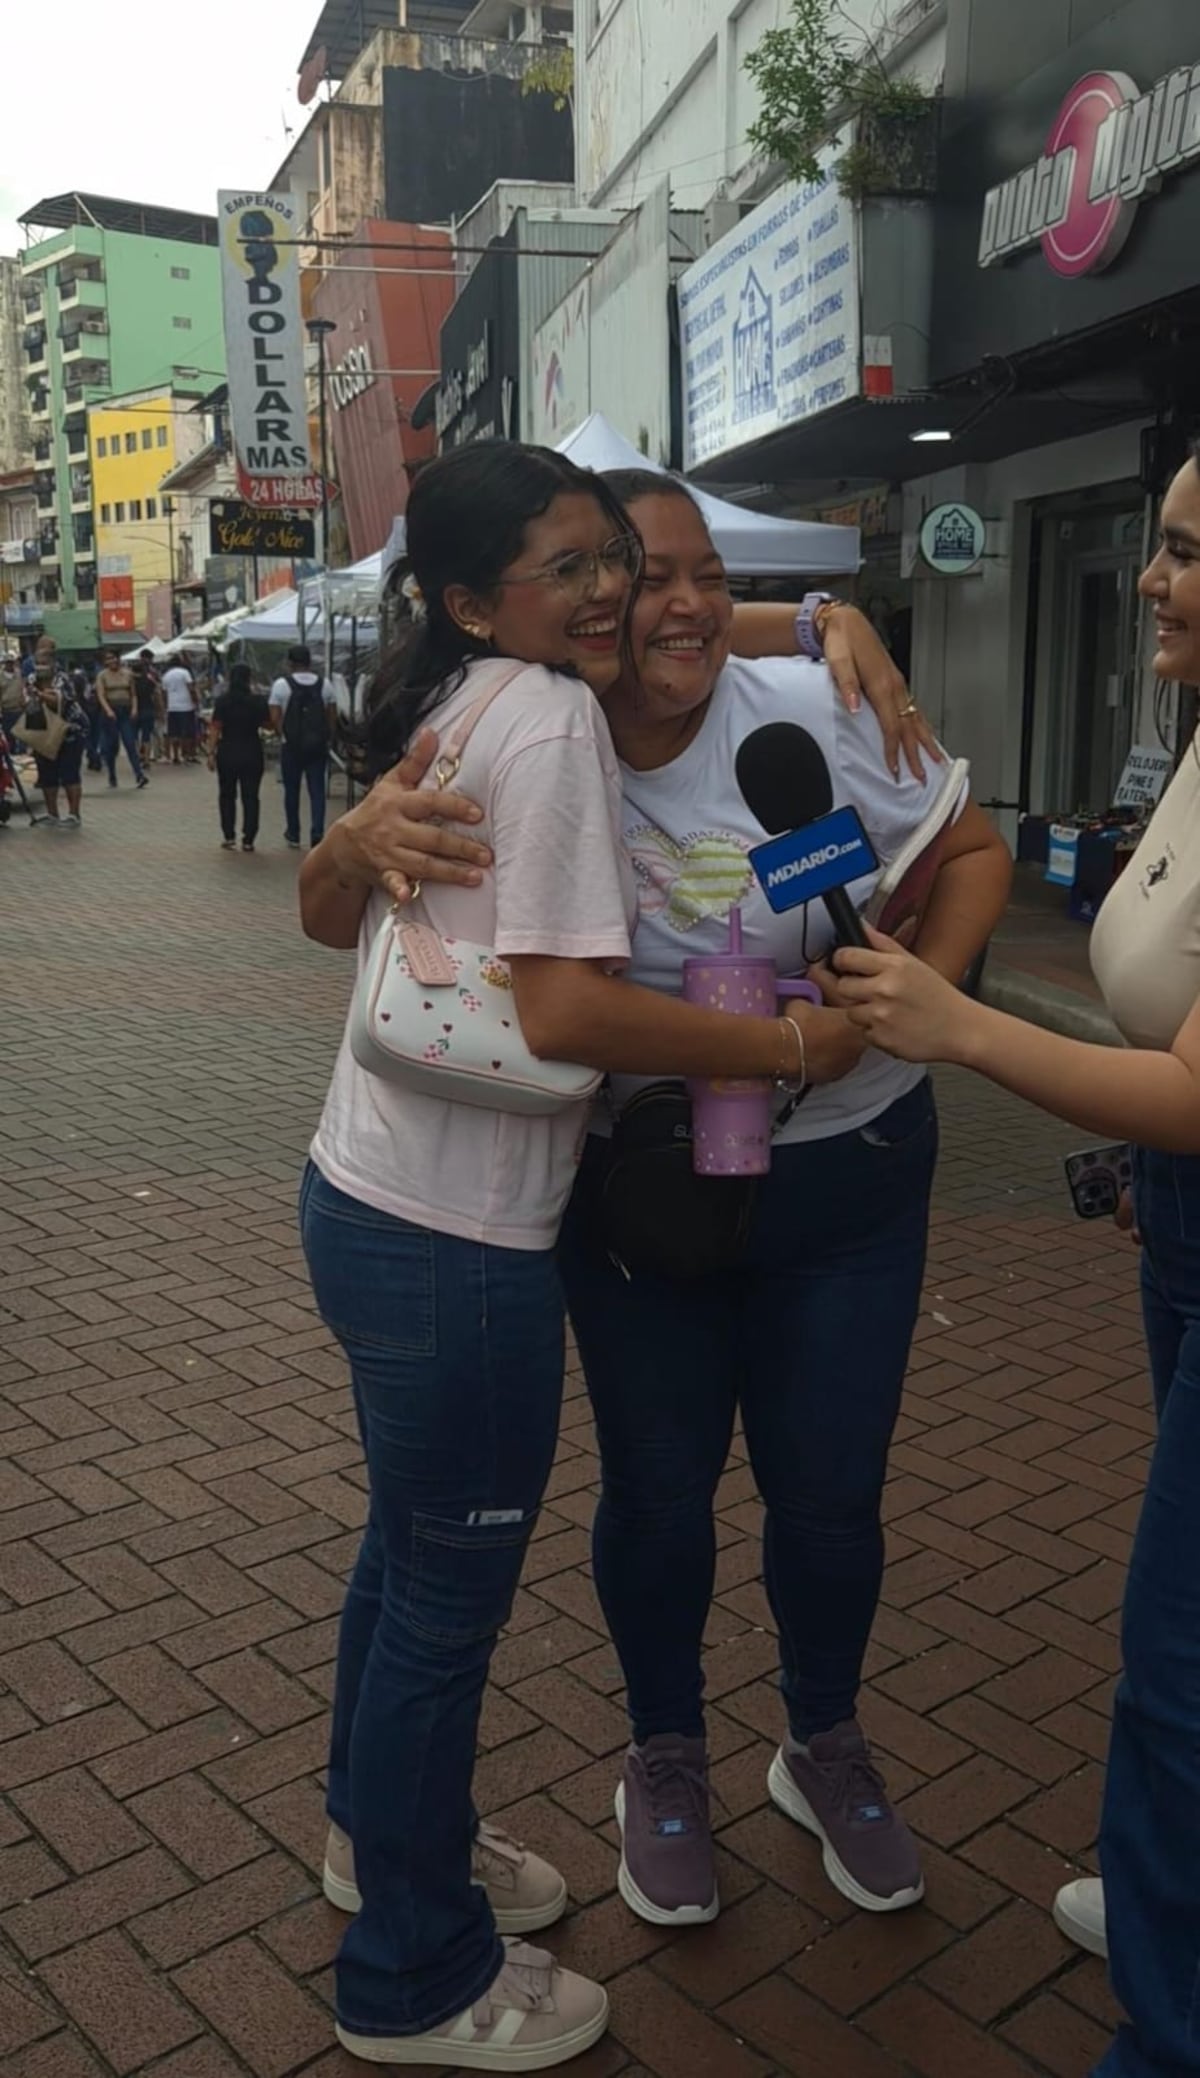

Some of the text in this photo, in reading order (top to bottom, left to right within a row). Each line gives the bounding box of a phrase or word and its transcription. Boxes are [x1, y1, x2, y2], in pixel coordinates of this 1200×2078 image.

[224, 193, 294, 220] EMPEÑOS
[245, 280, 293, 442] DOLLAR
[246, 445, 308, 469] MAS
[250, 480, 270, 501] 24
[935, 528, 974, 542] HOME
